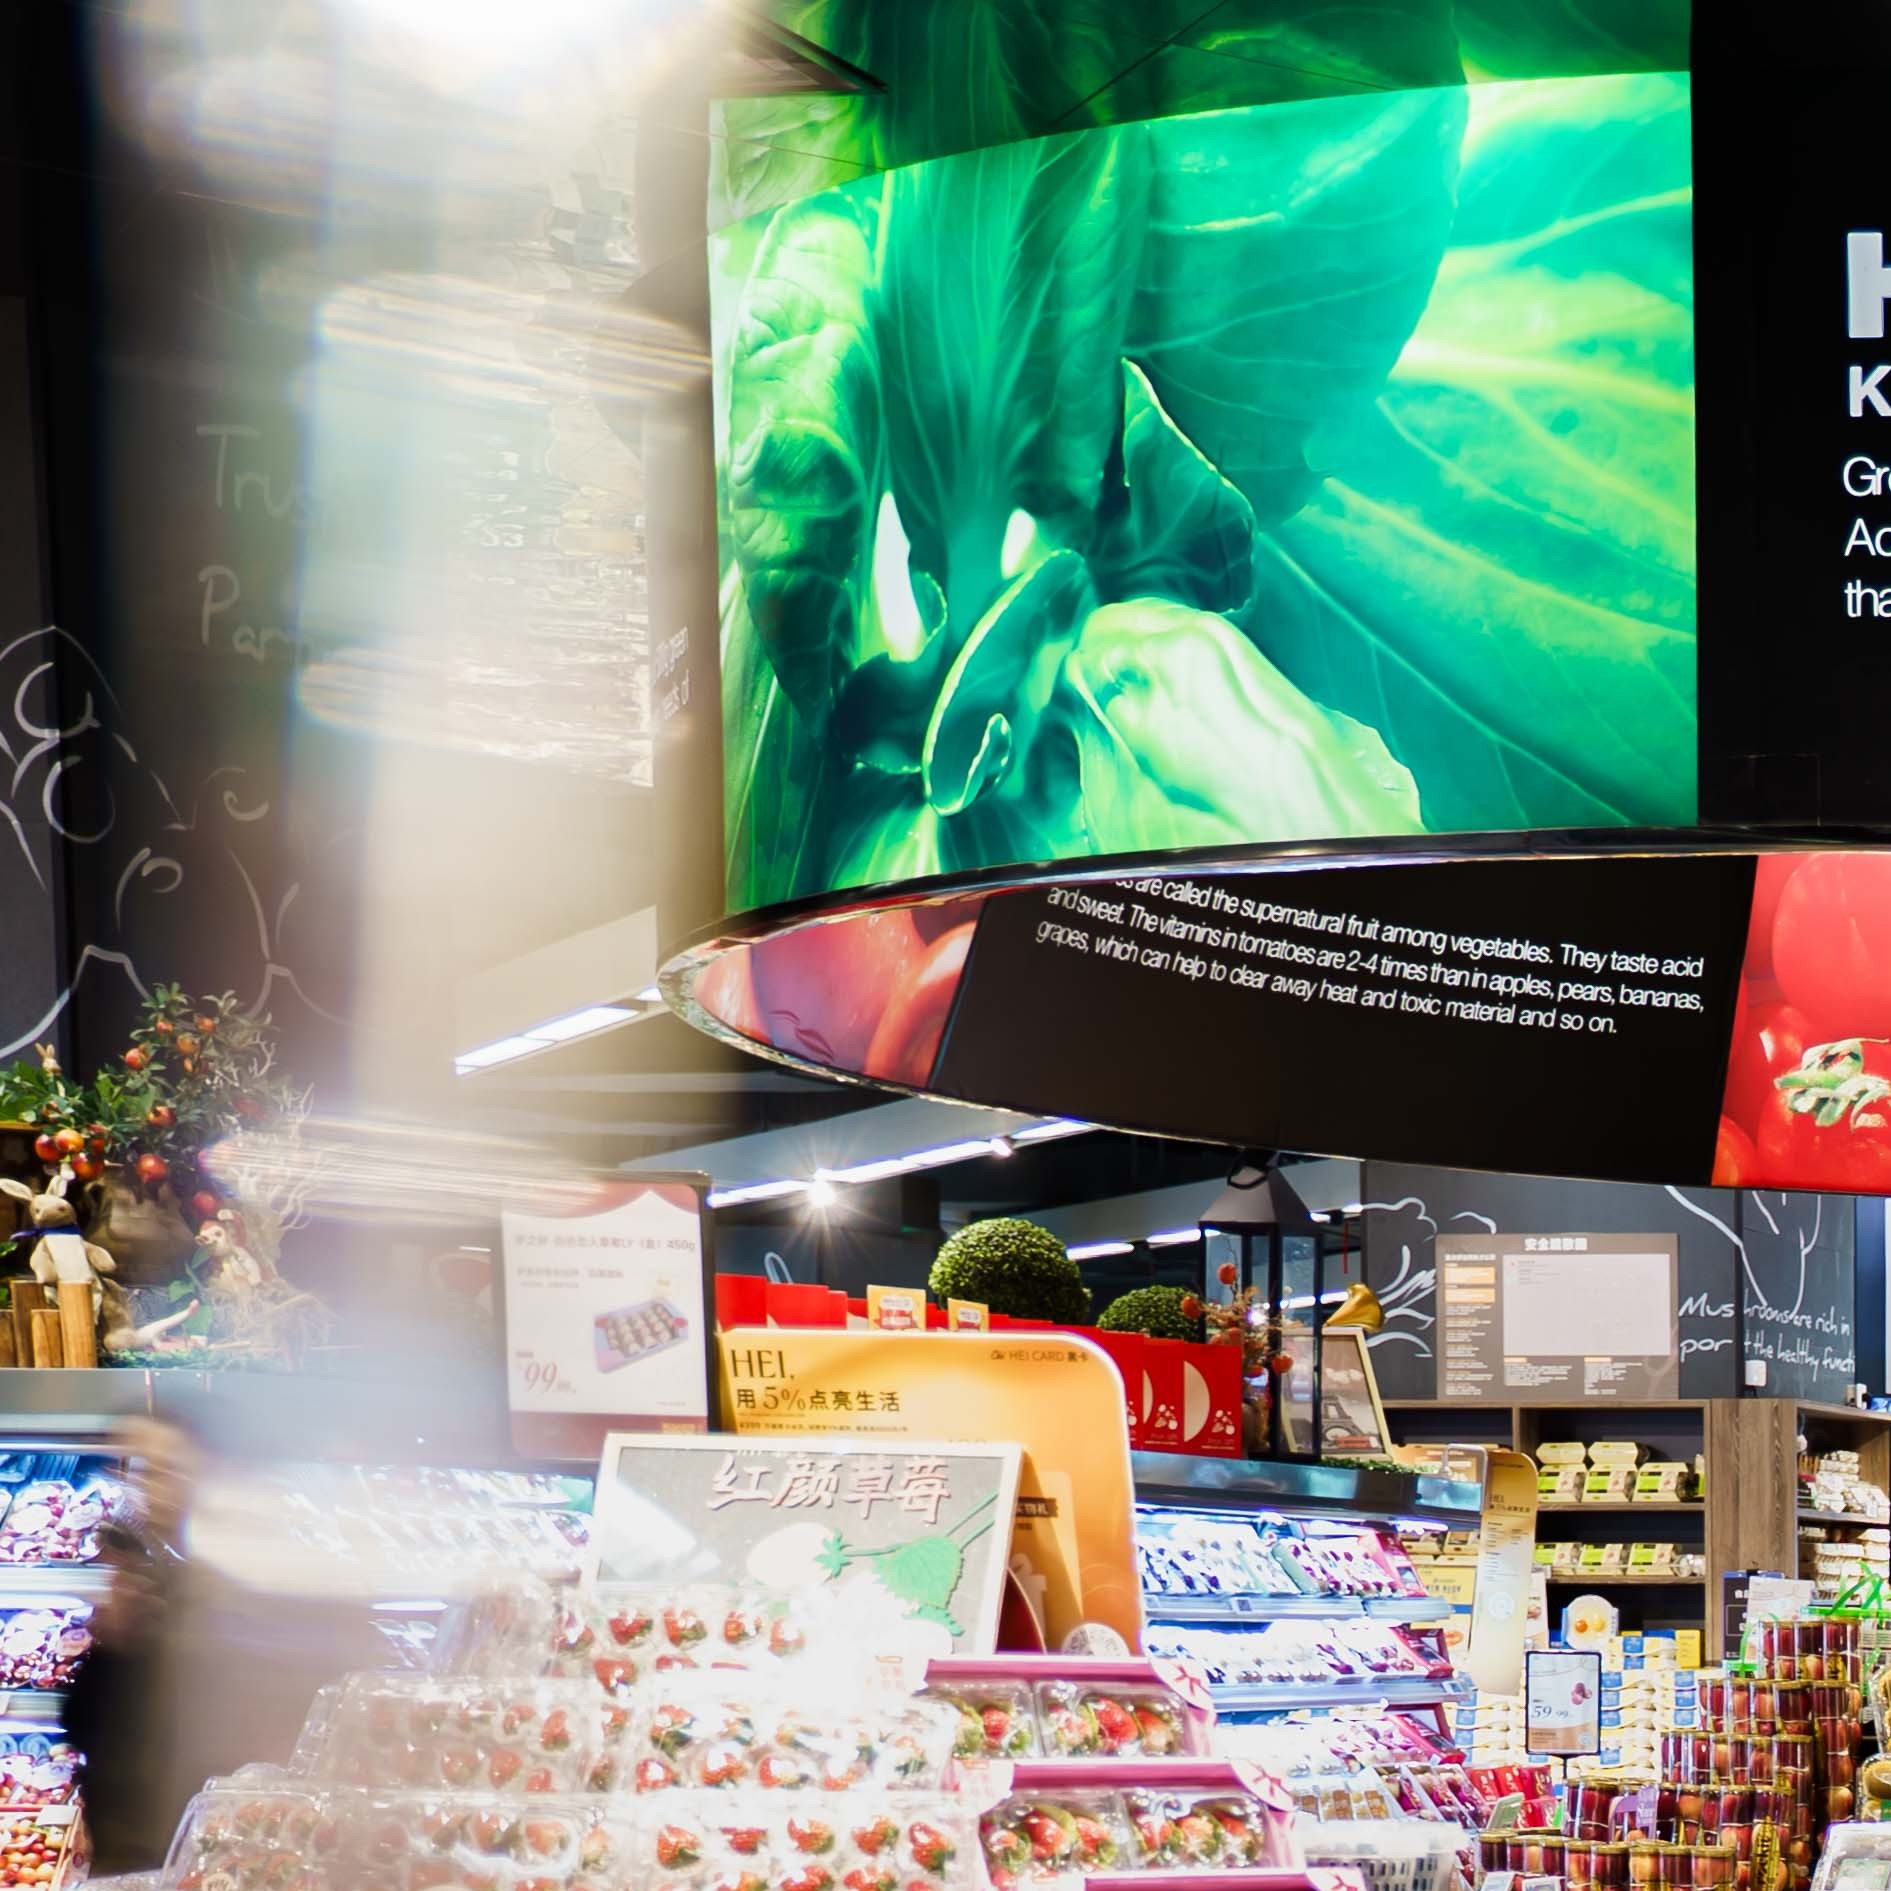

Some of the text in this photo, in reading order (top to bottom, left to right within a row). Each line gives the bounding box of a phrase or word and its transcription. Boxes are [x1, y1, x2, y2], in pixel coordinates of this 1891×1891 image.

[1036, 921, 1617, 1033] grapes, which can help to clear away heat and toxic material and so on.
[730, 1349, 796, 1381] HEI,
[1009, 1350, 1065, 1363] HEI CARD
